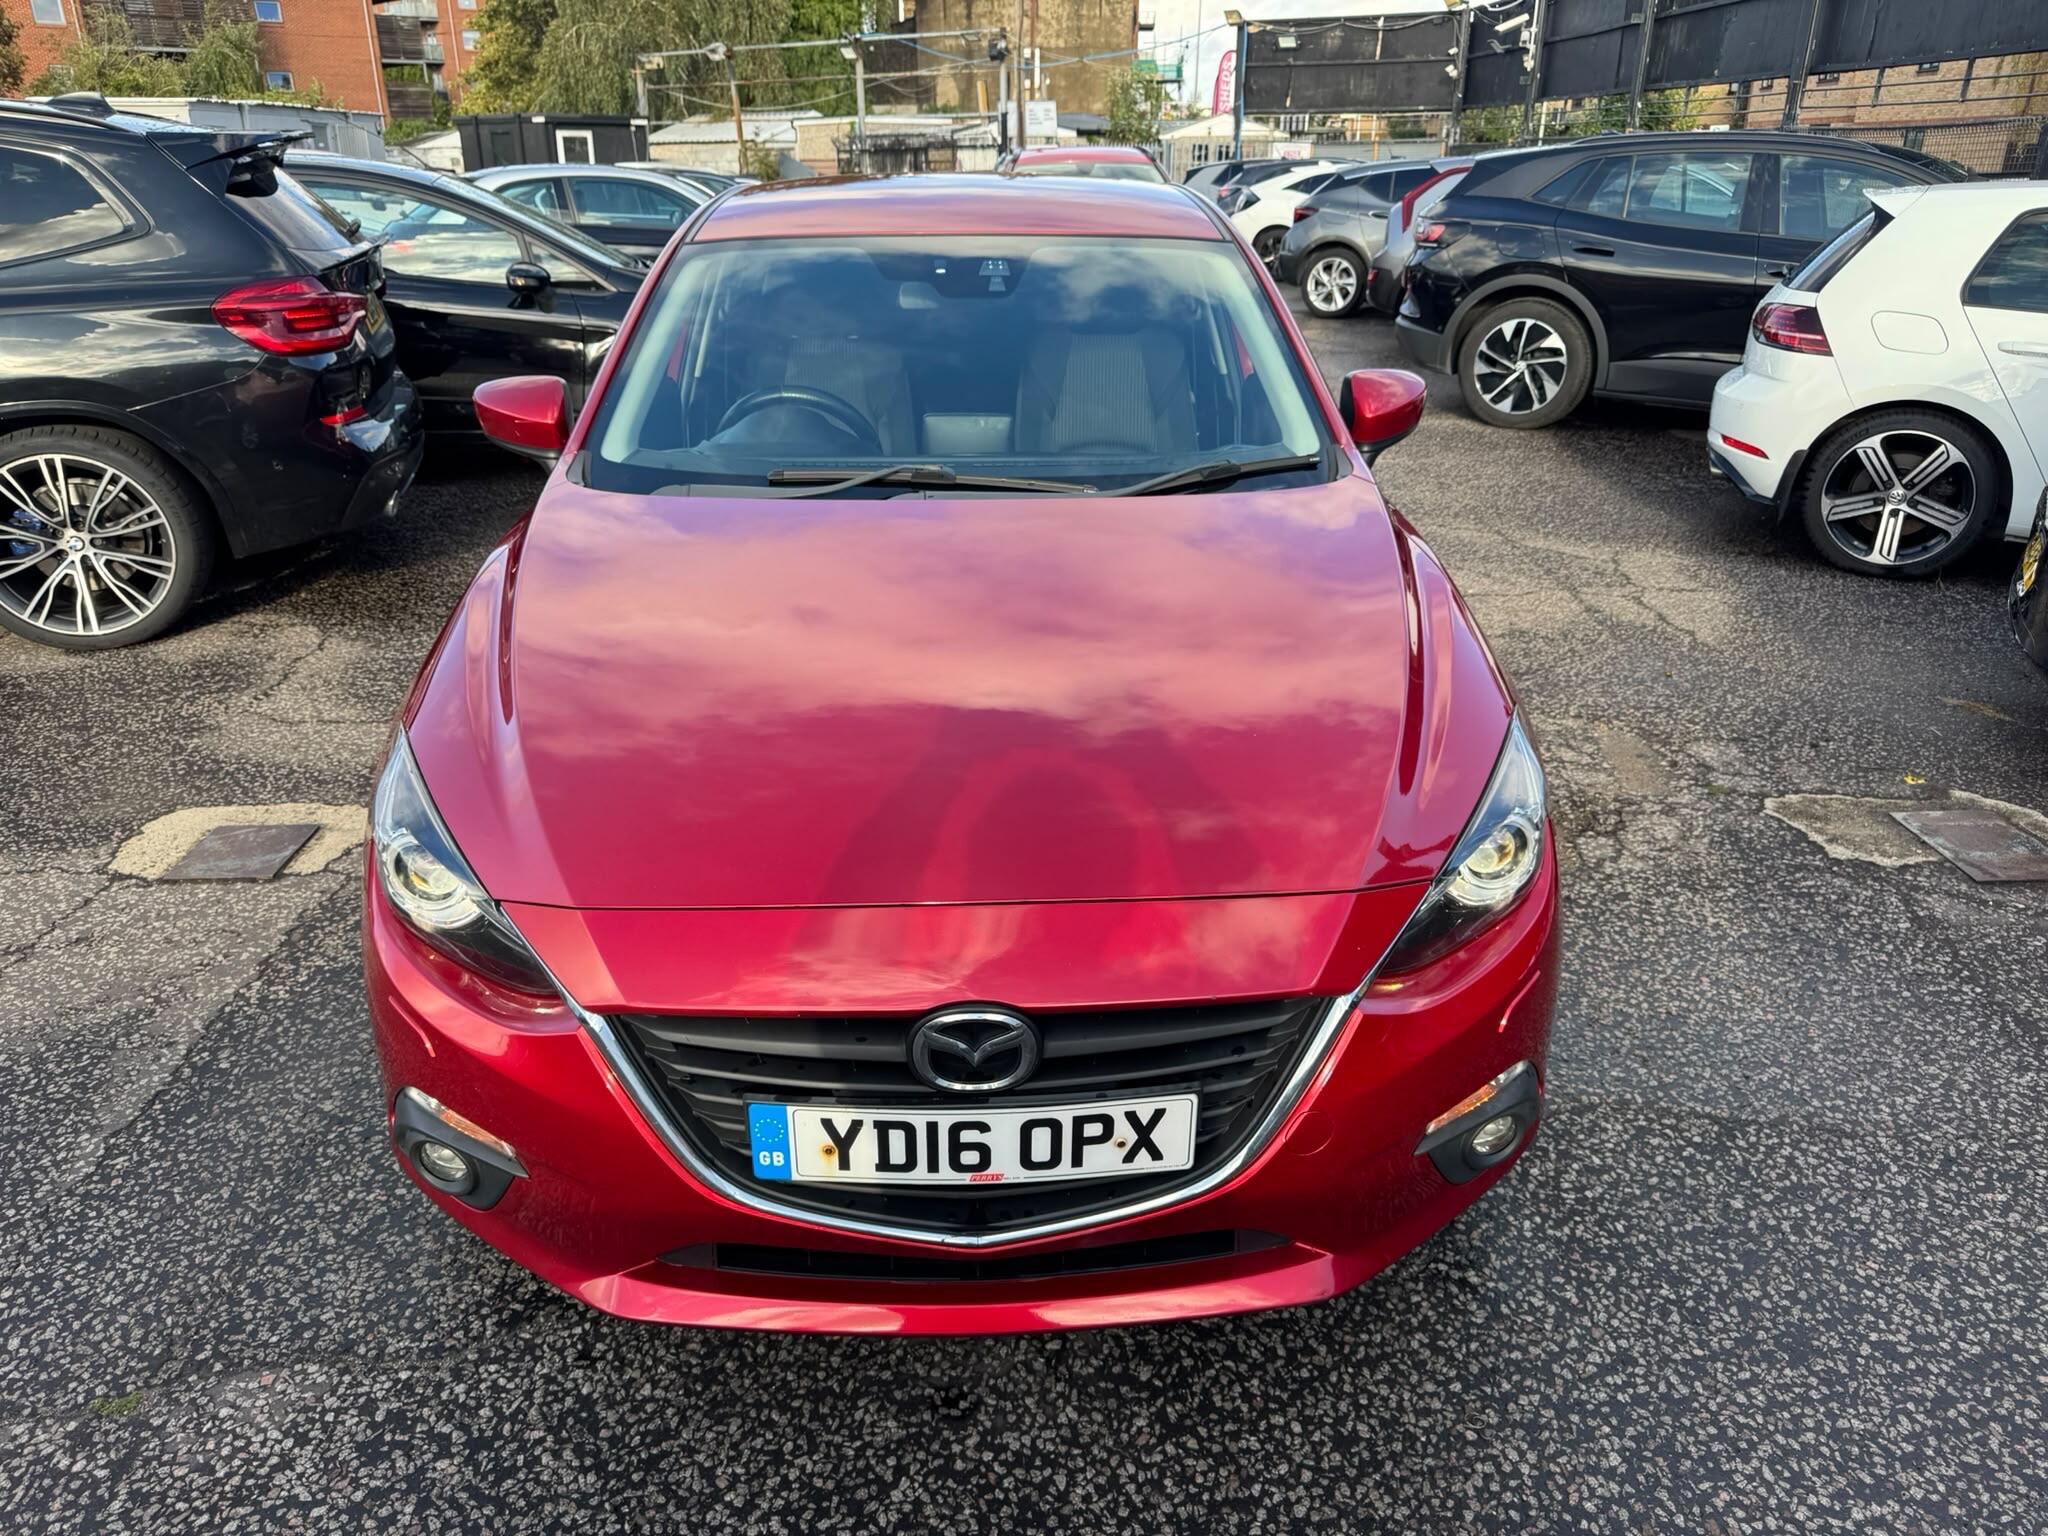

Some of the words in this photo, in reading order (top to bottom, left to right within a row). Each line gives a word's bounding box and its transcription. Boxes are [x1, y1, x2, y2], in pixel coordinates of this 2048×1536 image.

[759, 1151, 785, 1167] GB
[820, 1117, 991, 1174] YD16
[1019, 1107, 1167, 1171] OPX
